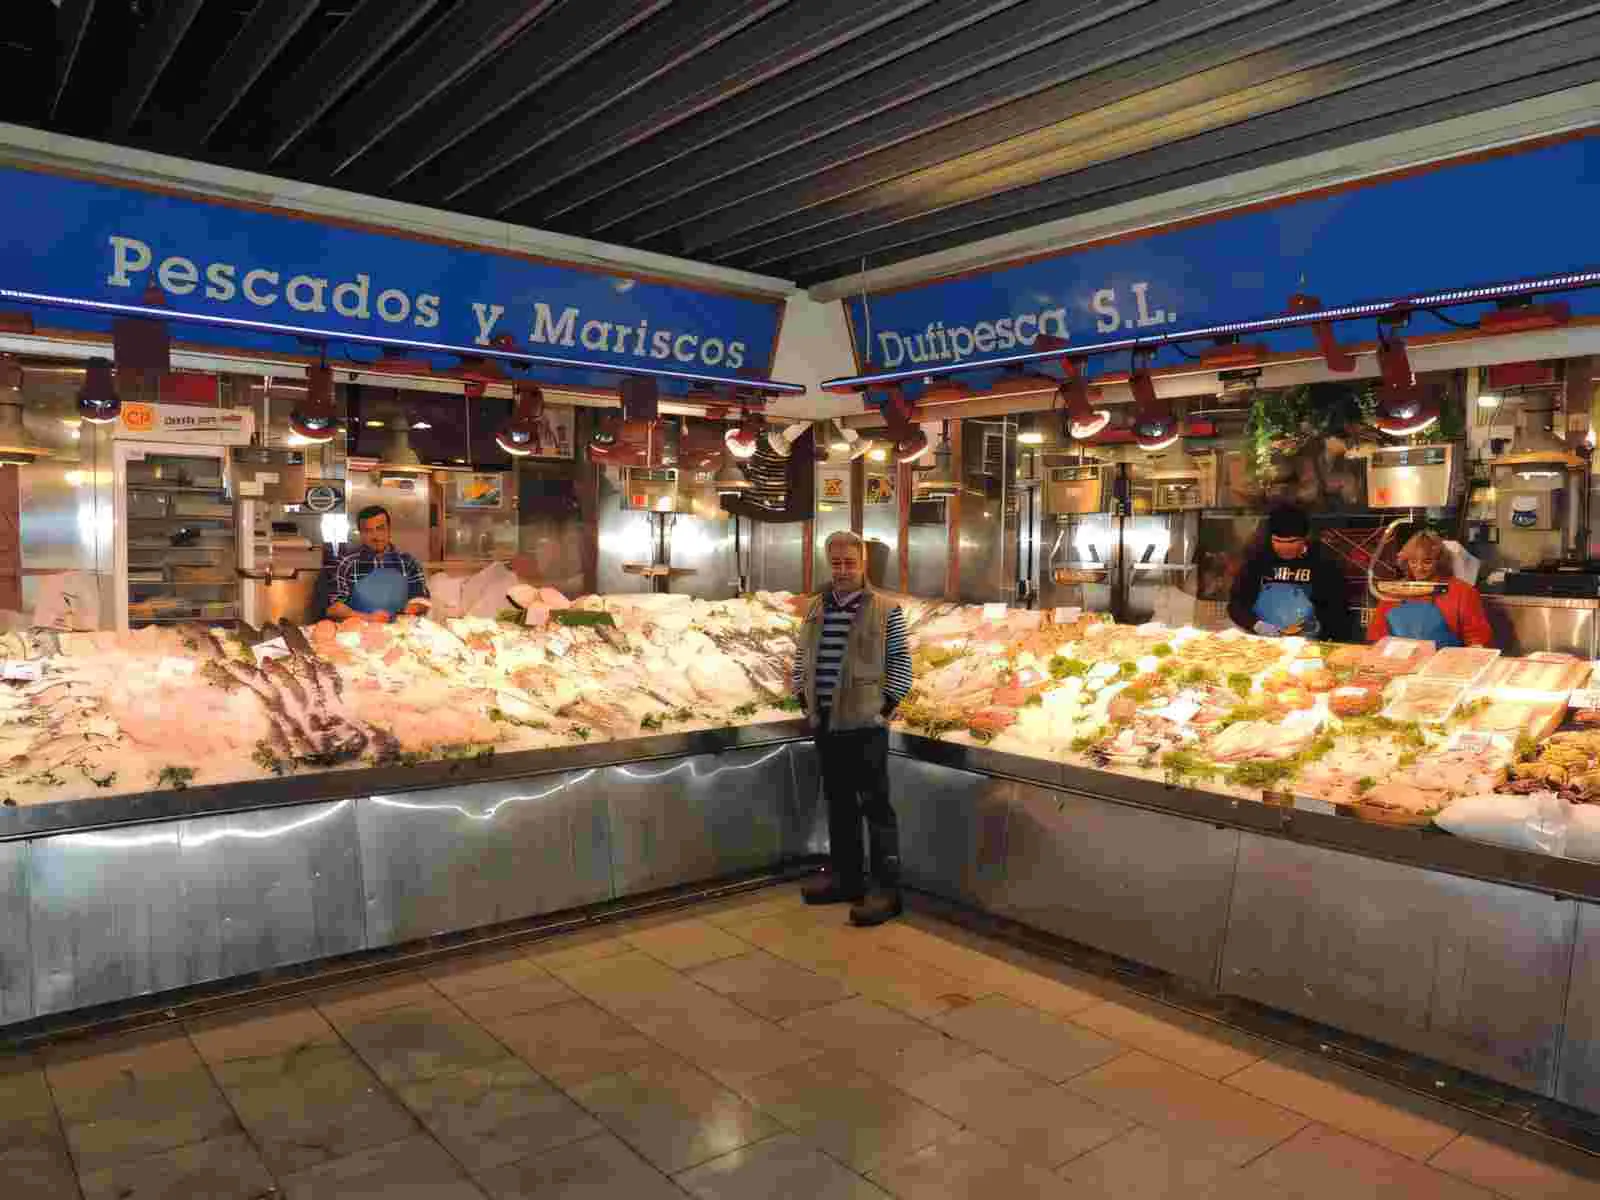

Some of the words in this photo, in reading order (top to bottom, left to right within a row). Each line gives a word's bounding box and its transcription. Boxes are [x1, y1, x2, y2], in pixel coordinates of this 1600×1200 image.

[107, 235, 441, 328] Pescados
[471, 302, 505, 346] y
[528, 302, 746, 369] Mariscos
[1091, 281, 1178, 334] S.L.
